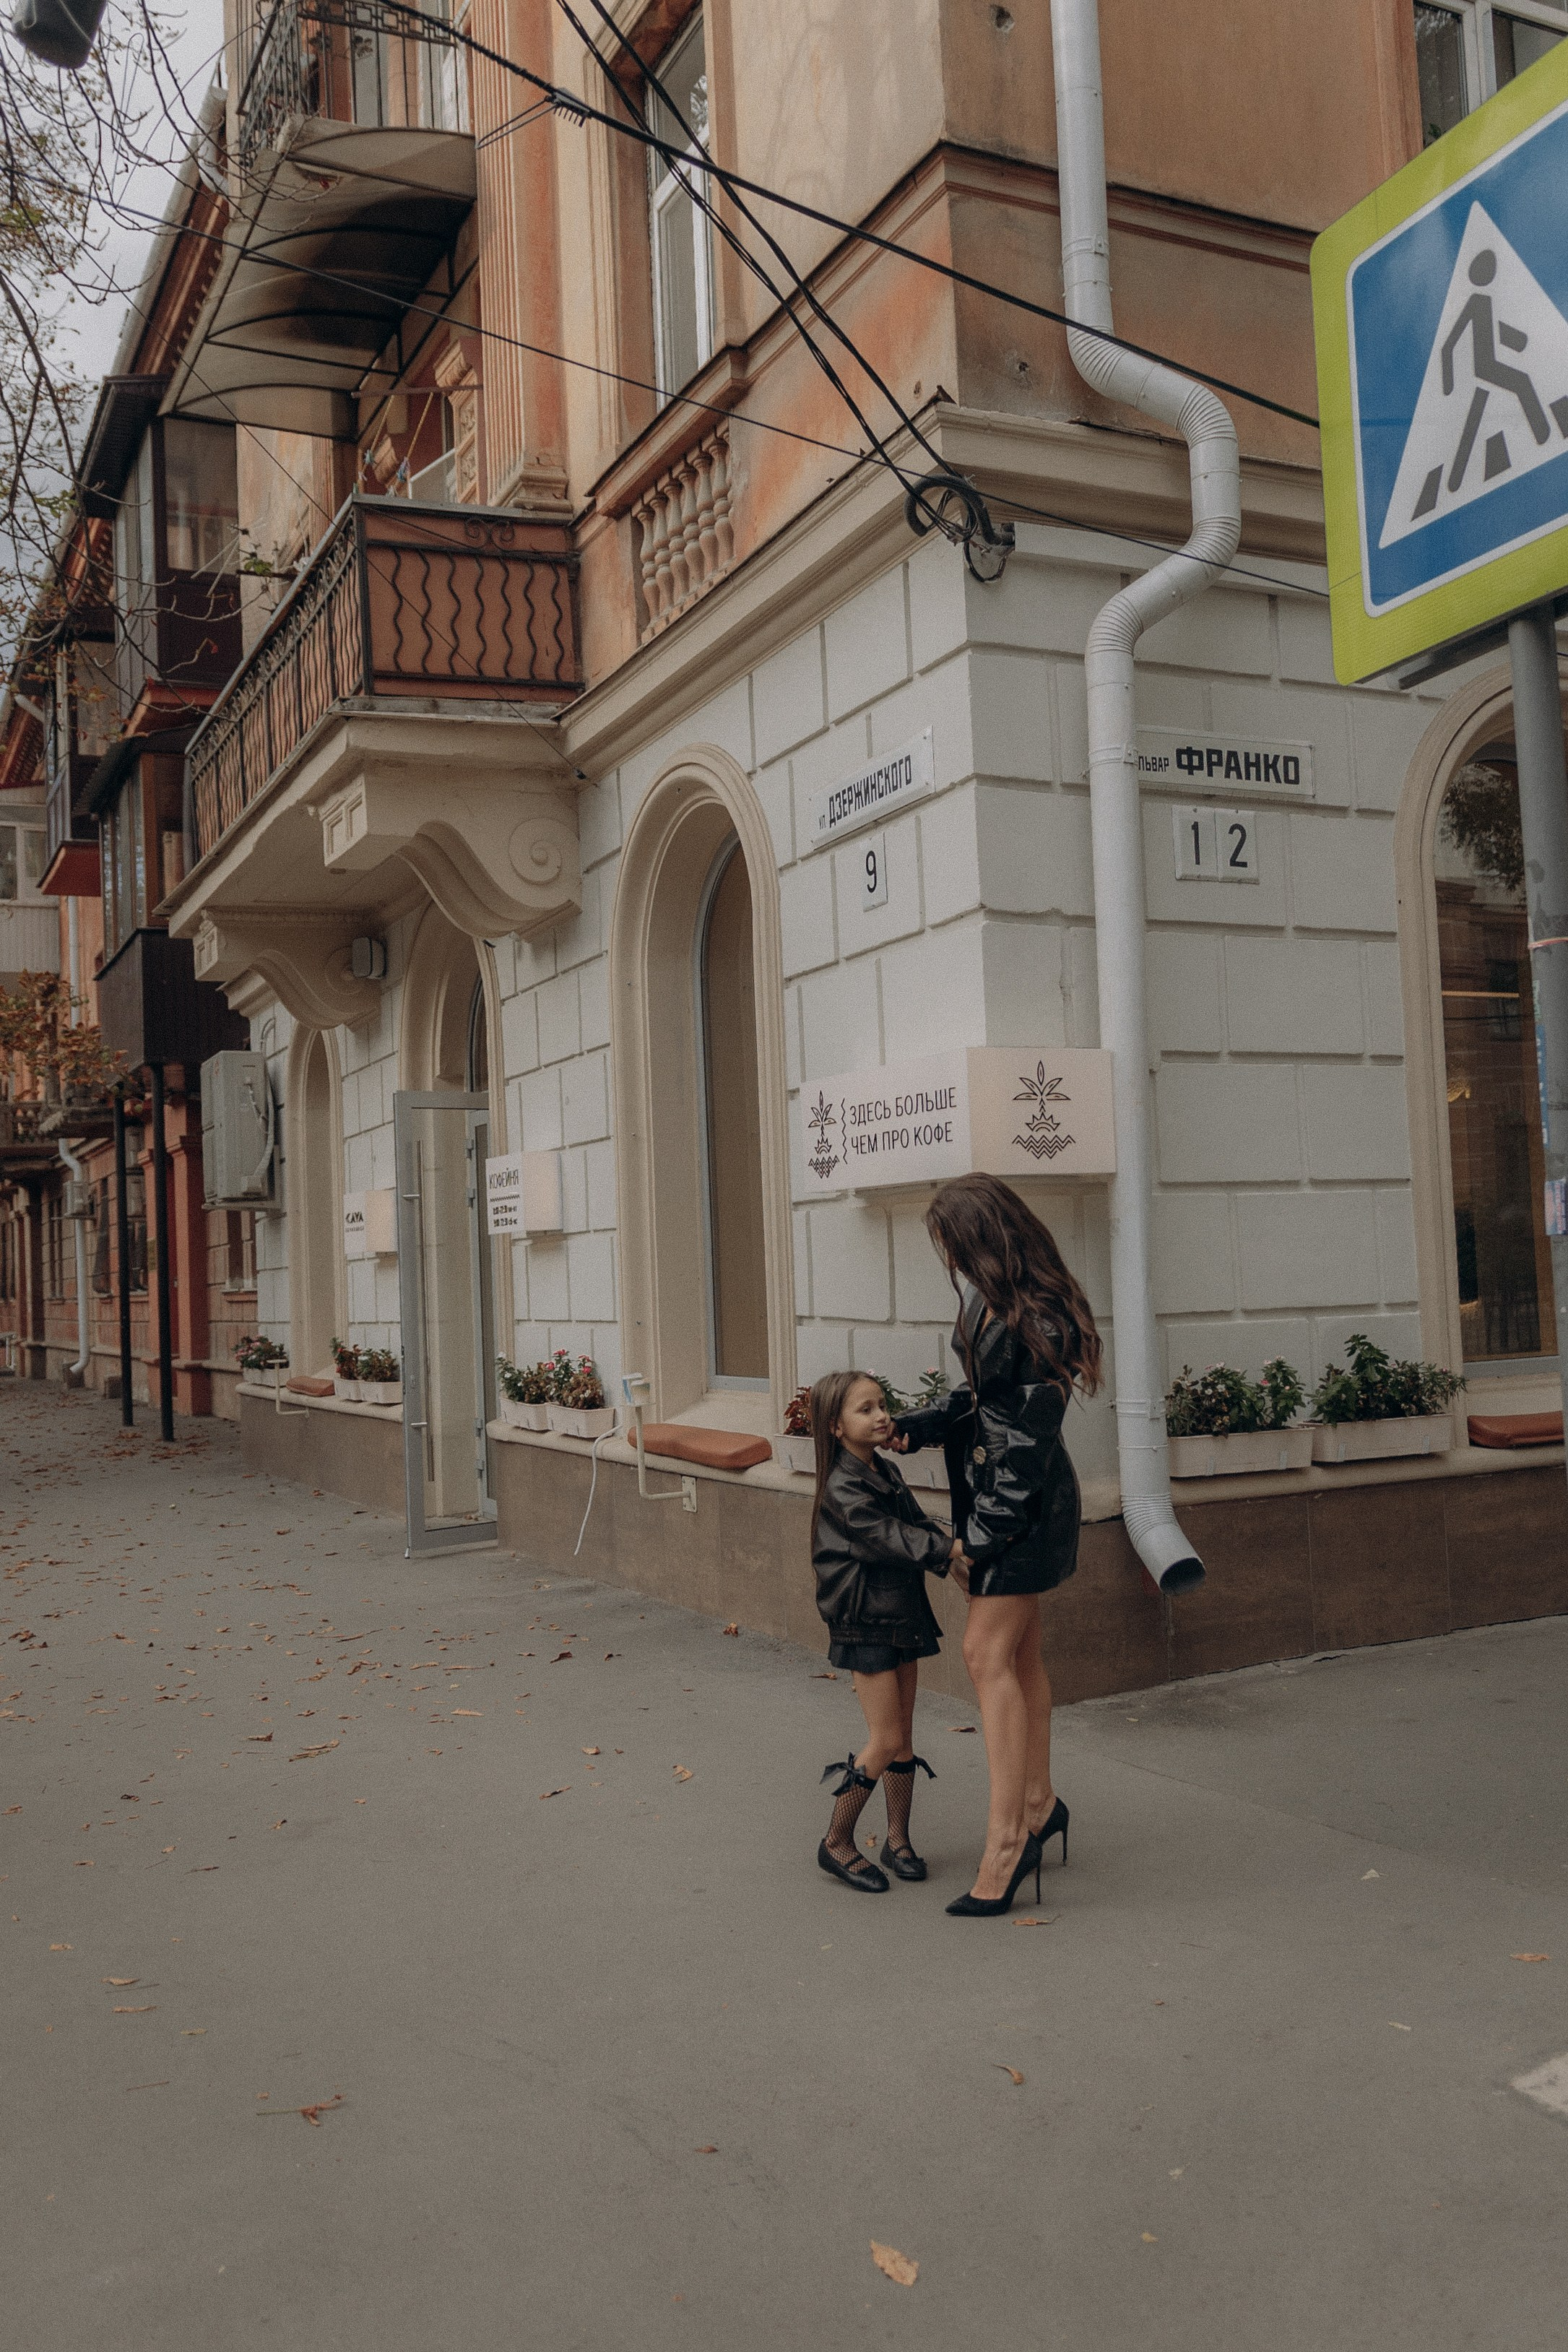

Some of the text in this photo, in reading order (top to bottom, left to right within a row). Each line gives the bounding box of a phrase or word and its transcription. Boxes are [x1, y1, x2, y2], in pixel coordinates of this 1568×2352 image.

[1176, 746, 1300, 784] ФРАНКО
[828, 754, 912, 828] ДЗЕРЖИНСКОГО
[866, 850, 878, 893] 9
[850, 1087, 957, 1126] ЗДЕСЬ БОЛЬШЕ
[852, 1121, 953, 1155] ЧЕМ ПРО КОФЕ
[489, 1167, 519, 1189] КОФЕЙНЯ
